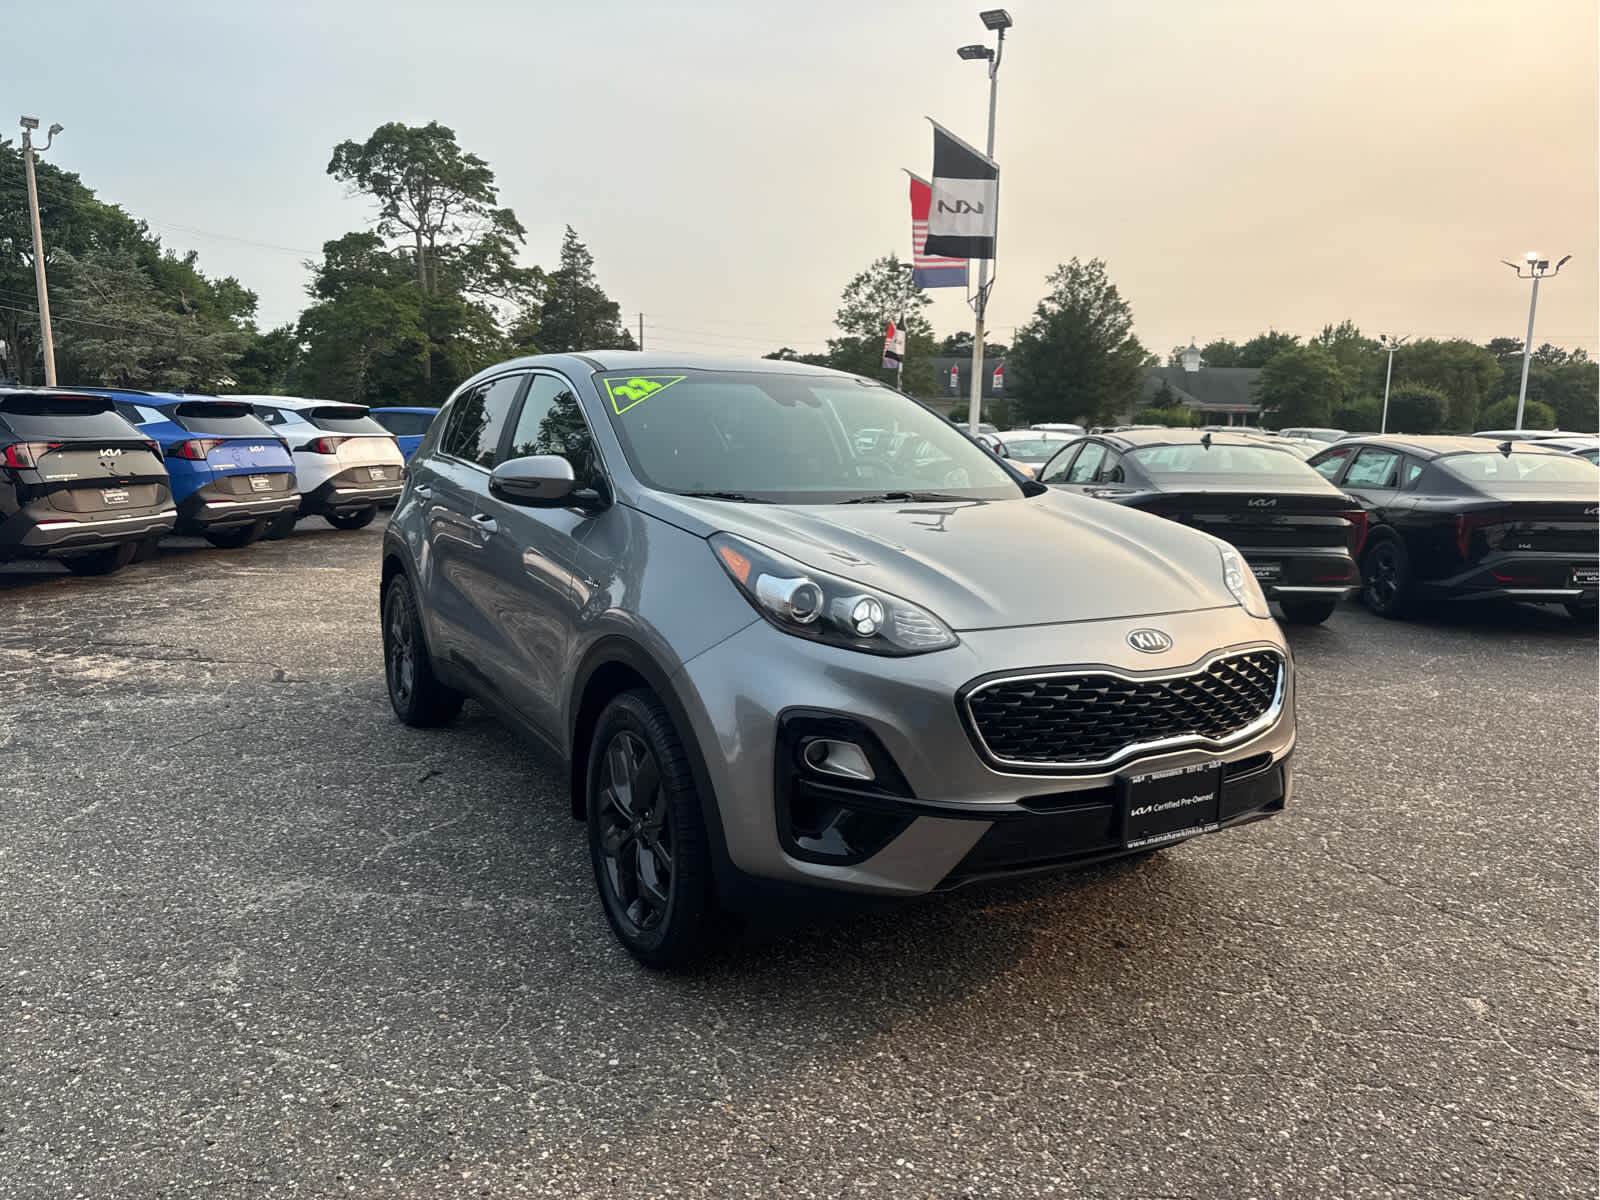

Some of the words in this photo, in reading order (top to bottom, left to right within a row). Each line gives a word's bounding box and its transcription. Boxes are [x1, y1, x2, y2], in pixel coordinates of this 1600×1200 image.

[613, 378, 662, 400] 22
[99, 448, 122, 457] KIA
[1247, 498, 1278, 507] KIA
[1132, 631, 1168, 649] KIA
[1130, 805, 1153, 817] KIA
[1153, 799, 1180, 812] Certified
[1180, 792, 1214, 806] Pre-Owned
[1127, 823, 1219, 848] www.manahawkinkia.com
